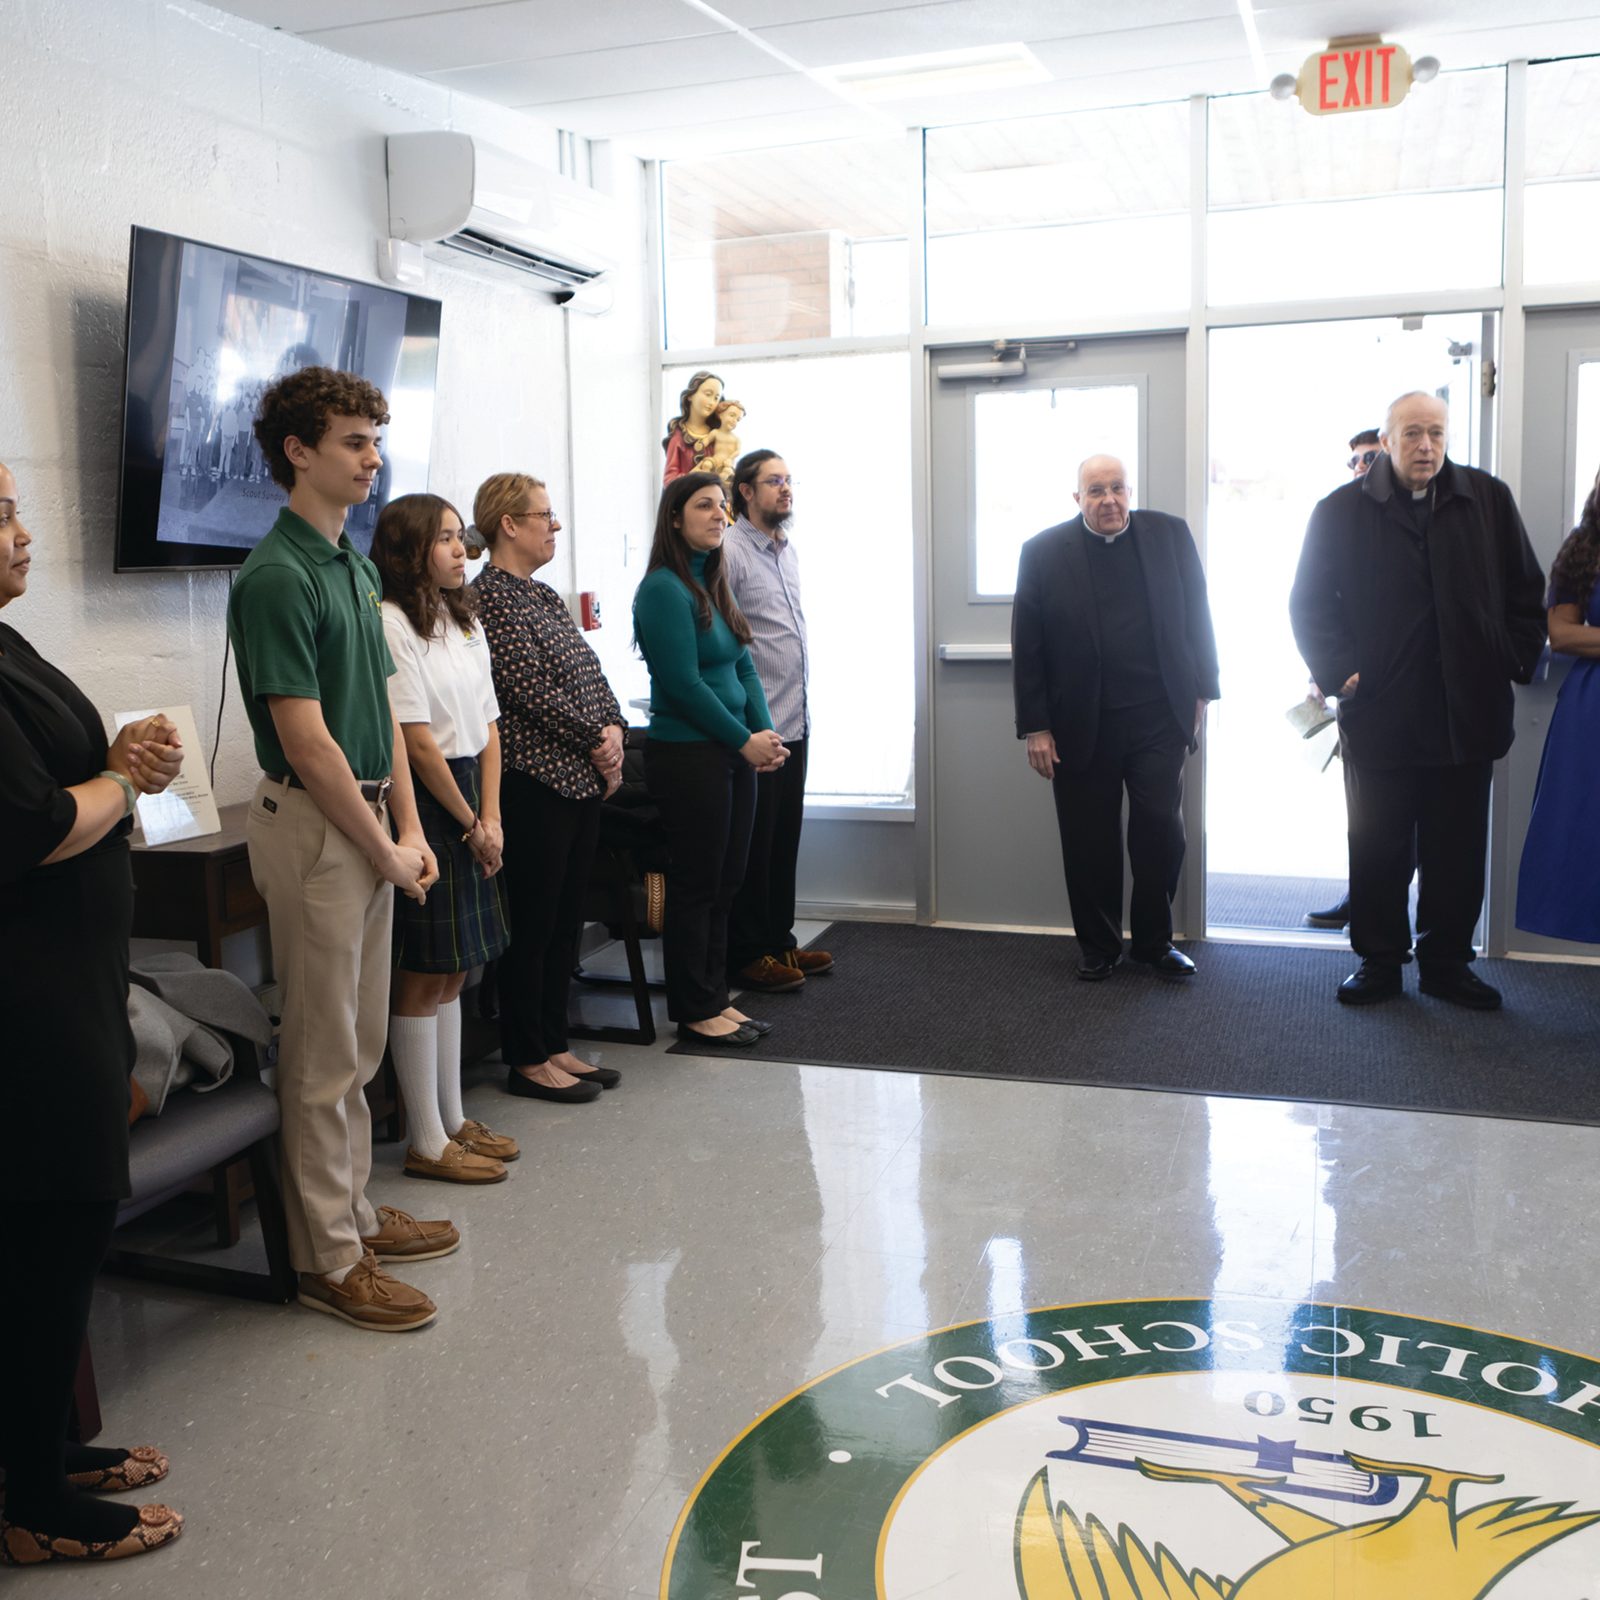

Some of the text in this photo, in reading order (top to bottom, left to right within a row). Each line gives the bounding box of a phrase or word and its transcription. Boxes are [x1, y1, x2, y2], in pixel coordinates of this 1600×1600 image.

[1319, 46, 1396, 110] EXIT
[875, 1321, 1264, 1408] SCHOOL
[1243, 1390, 1442, 1438] 1950
